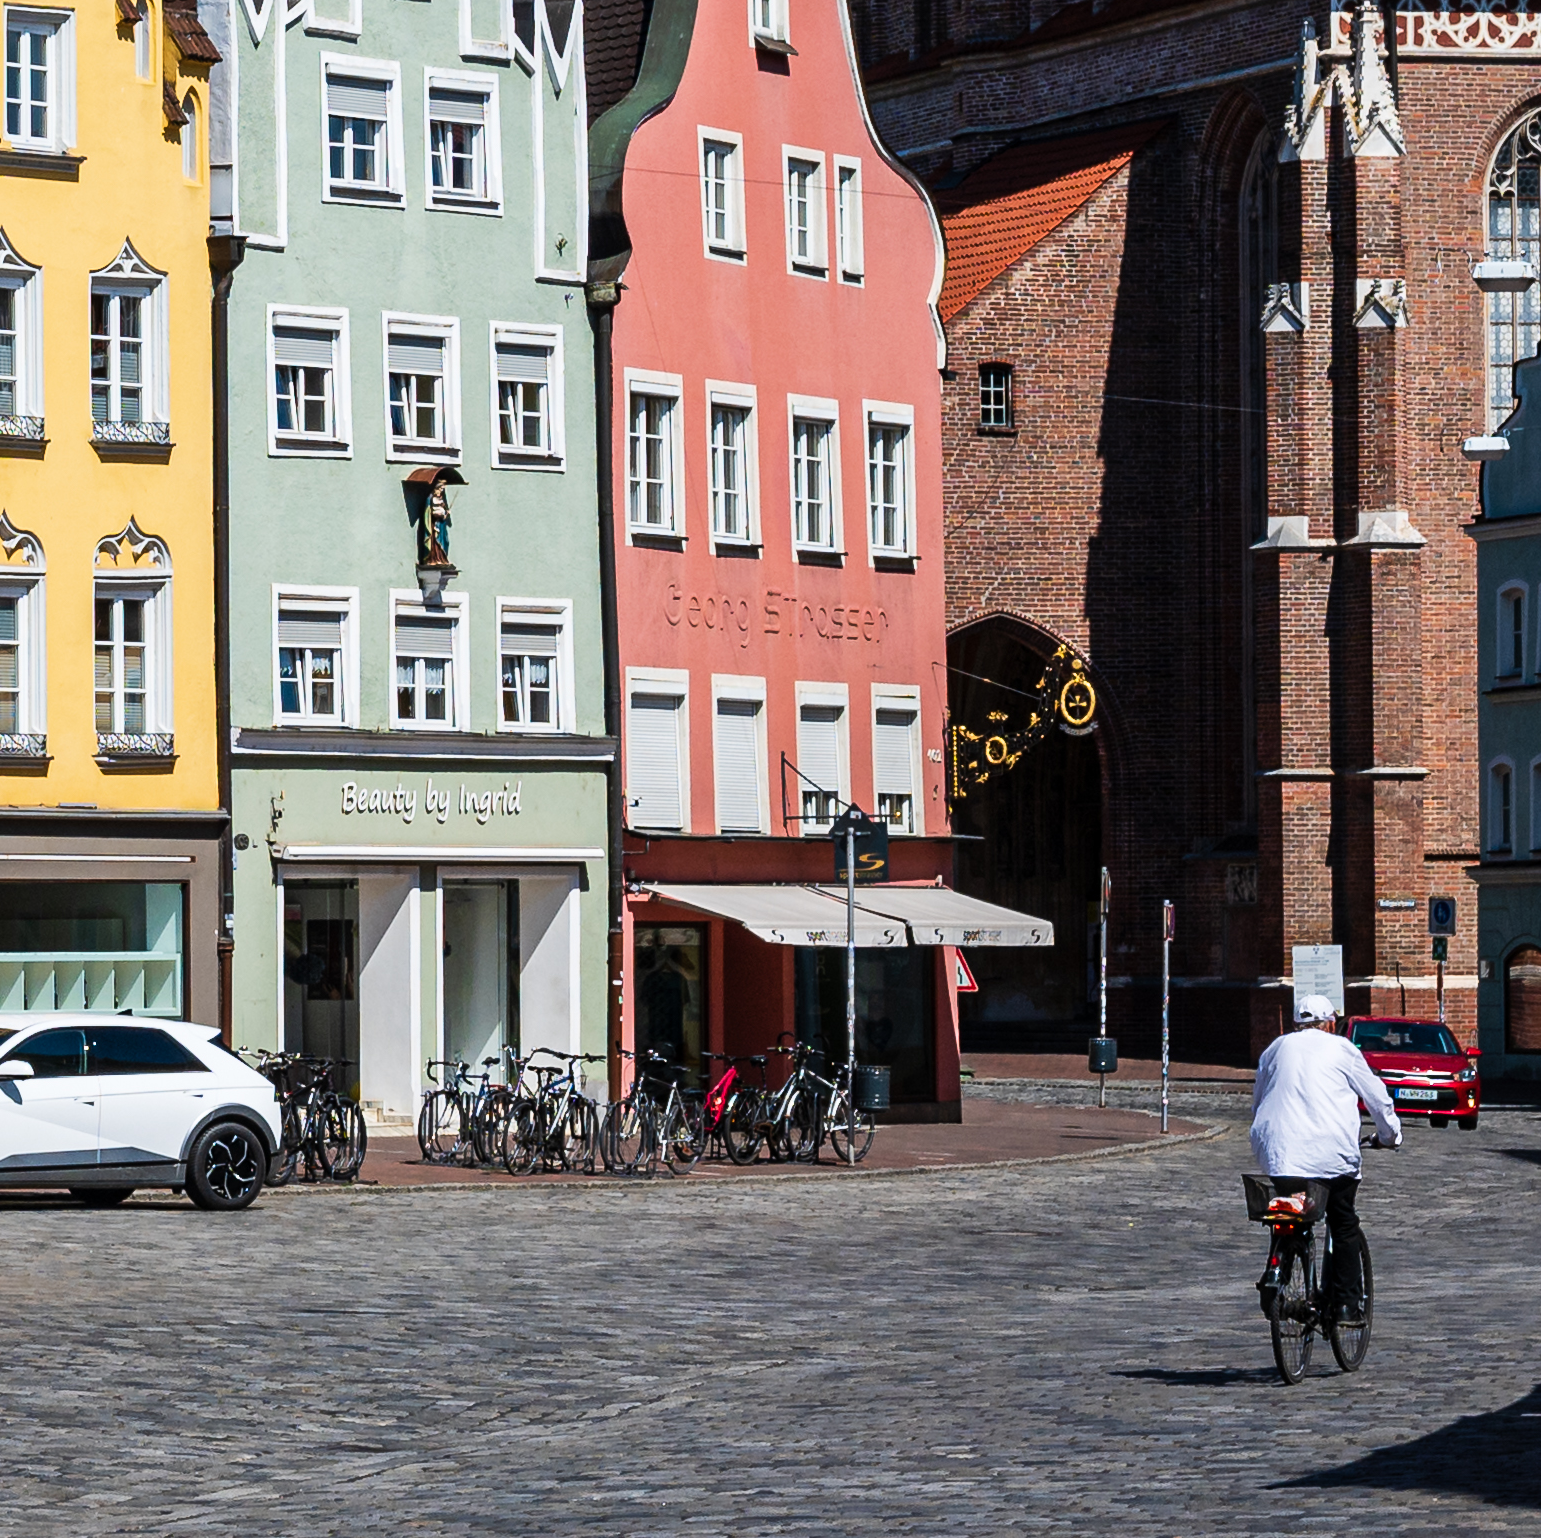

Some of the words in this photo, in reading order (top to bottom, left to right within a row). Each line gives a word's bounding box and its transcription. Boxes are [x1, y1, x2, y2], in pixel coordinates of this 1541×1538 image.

[664, 583, 751, 649] Georg
[342, 781, 417, 823] Beauty
[425, 778, 450, 823] by
[459, 780, 522, 824] Ingrid
